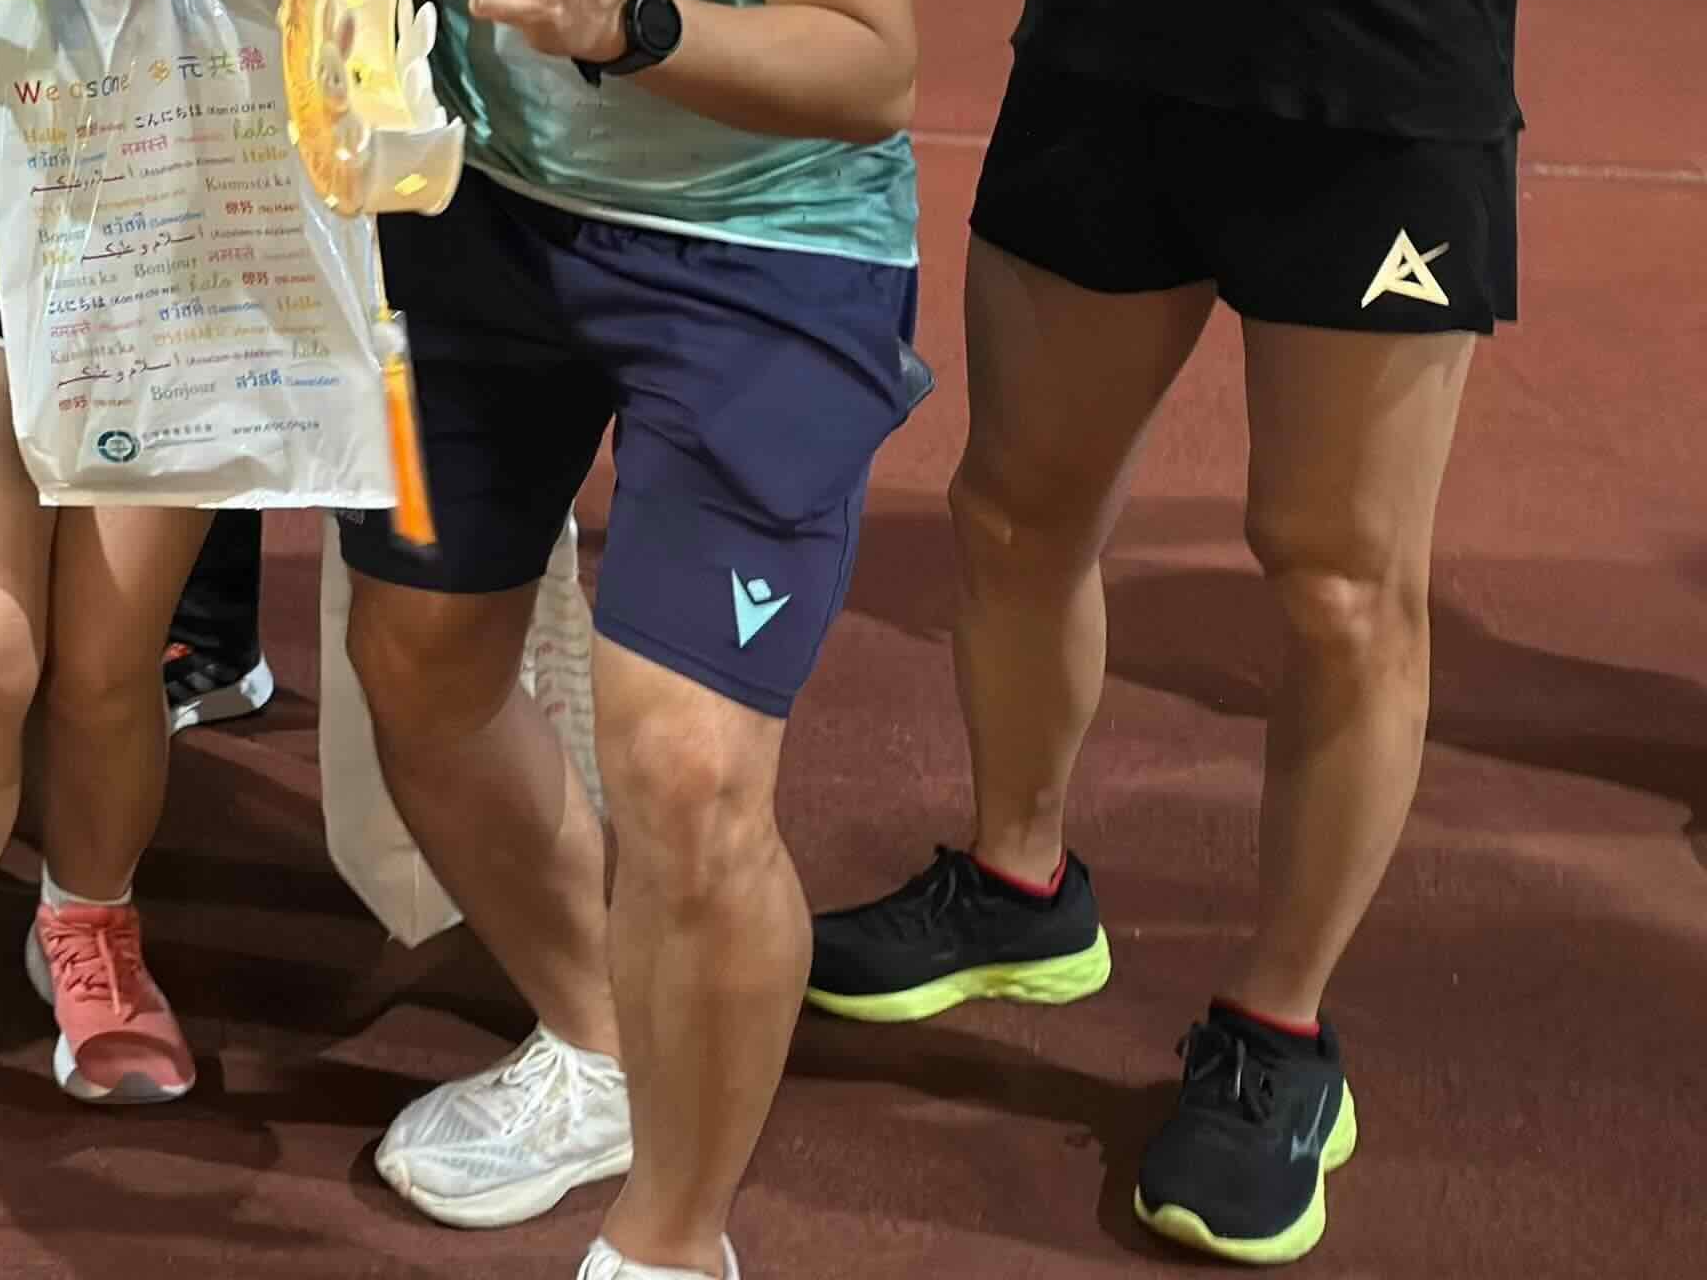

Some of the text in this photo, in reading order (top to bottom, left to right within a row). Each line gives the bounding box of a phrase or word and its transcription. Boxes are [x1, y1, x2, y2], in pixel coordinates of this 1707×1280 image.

[14, 80, 60, 105] We
[135, 104, 204, 129] こんにちは
